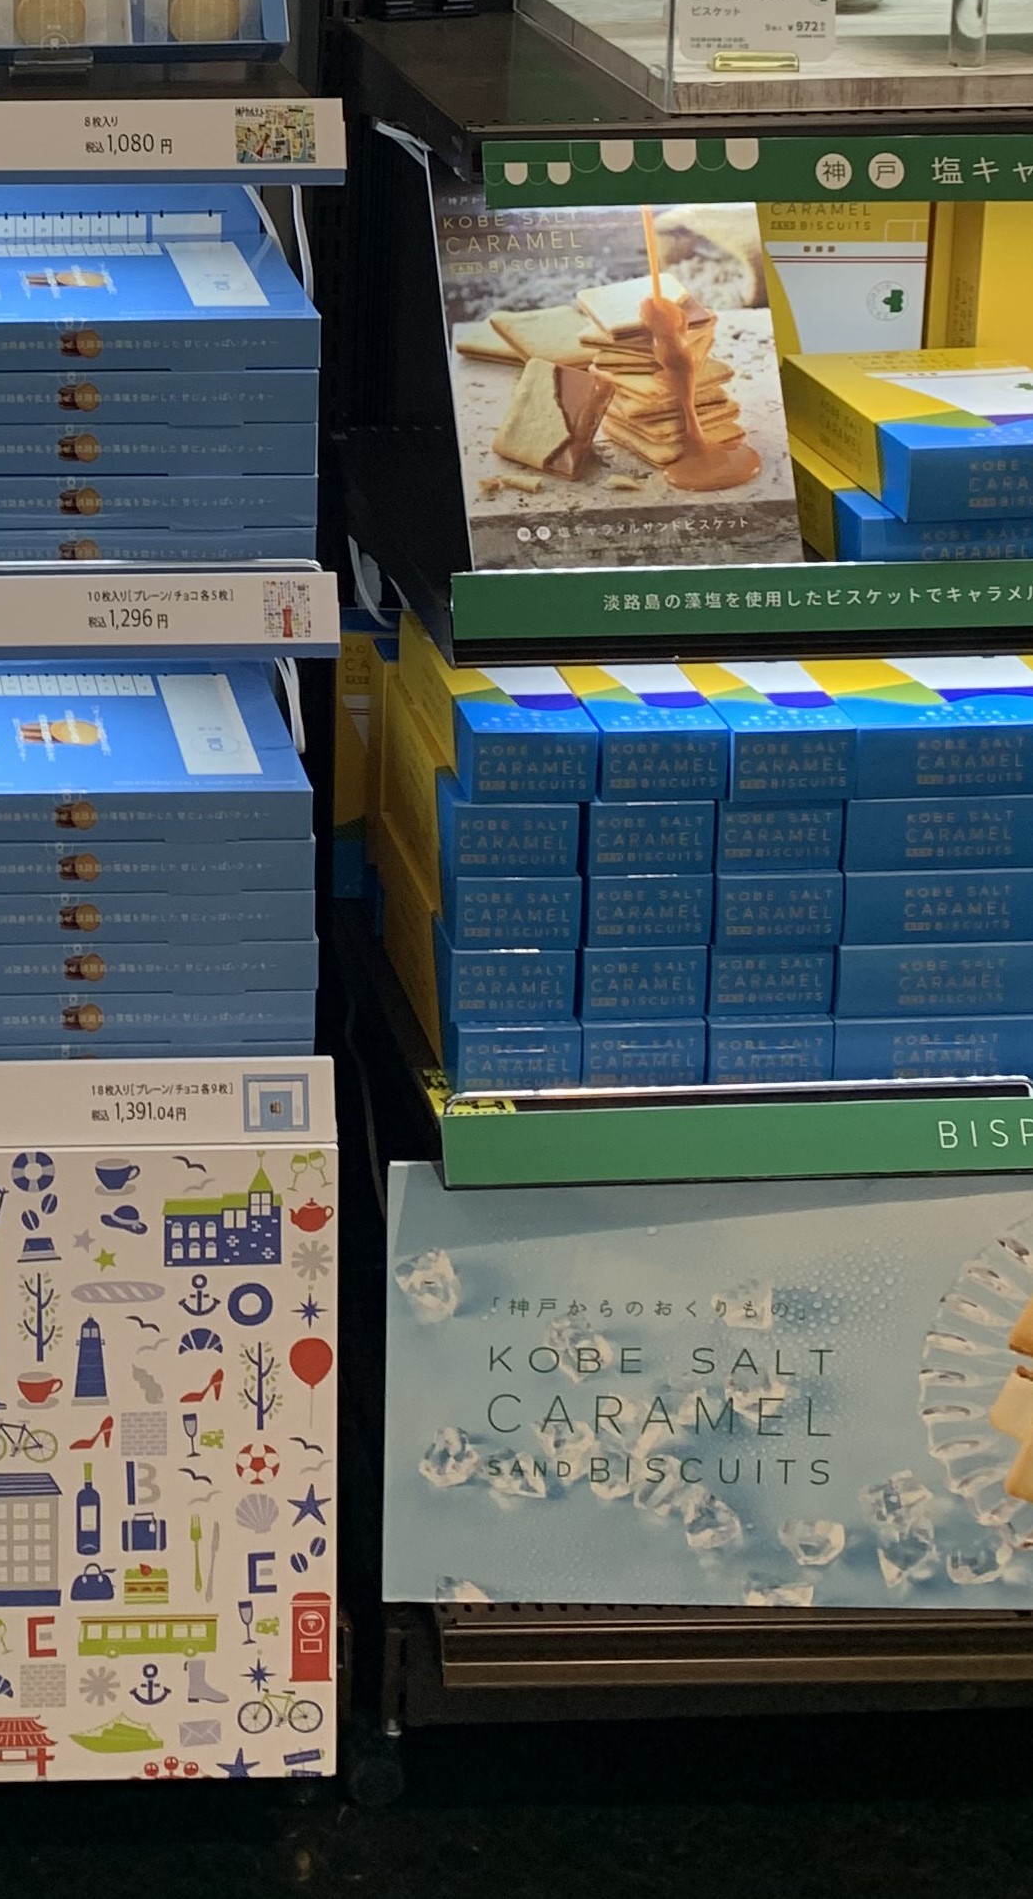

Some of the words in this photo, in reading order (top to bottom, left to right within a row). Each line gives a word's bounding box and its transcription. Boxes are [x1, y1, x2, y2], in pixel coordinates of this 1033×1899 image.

[691, 6, 741, 17] ビスケット
[84, 116, 119, 128] 8枚入り
[771, 202, 871, 216] CARAMEL
[442, 215, 505, 230] KOBE
[522, 208, 579, 226] SALT
[800, 220, 871, 231] BISCUITS
[445, 231, 583, 254] CARAMEL
[489, 255, 586, 274] BISCUITS
[479, 759, 587, 775] CARAMEL
[610, 757, 718, 774] CARAMEL
[739, 758, 847, 774] CARAMEL
[917, 754, 1024, 769] CARAMEL
[460, 834, 567, 851] CARAMEL
[596, 832, 702, 847] CARAMEL
[724, 828, 831, 843] CARAMEL
[906, 826, 1012, 843] CARAMEL
[489, 1346, 643, 1374] KOBE
[691, 1347, 834, 1376] SALT
[487, 1394, 832, 1437] CARAMEL
[488, 1459, 572, 1479] SAND
[589, 1457, 830, 1486] BISCUITS
